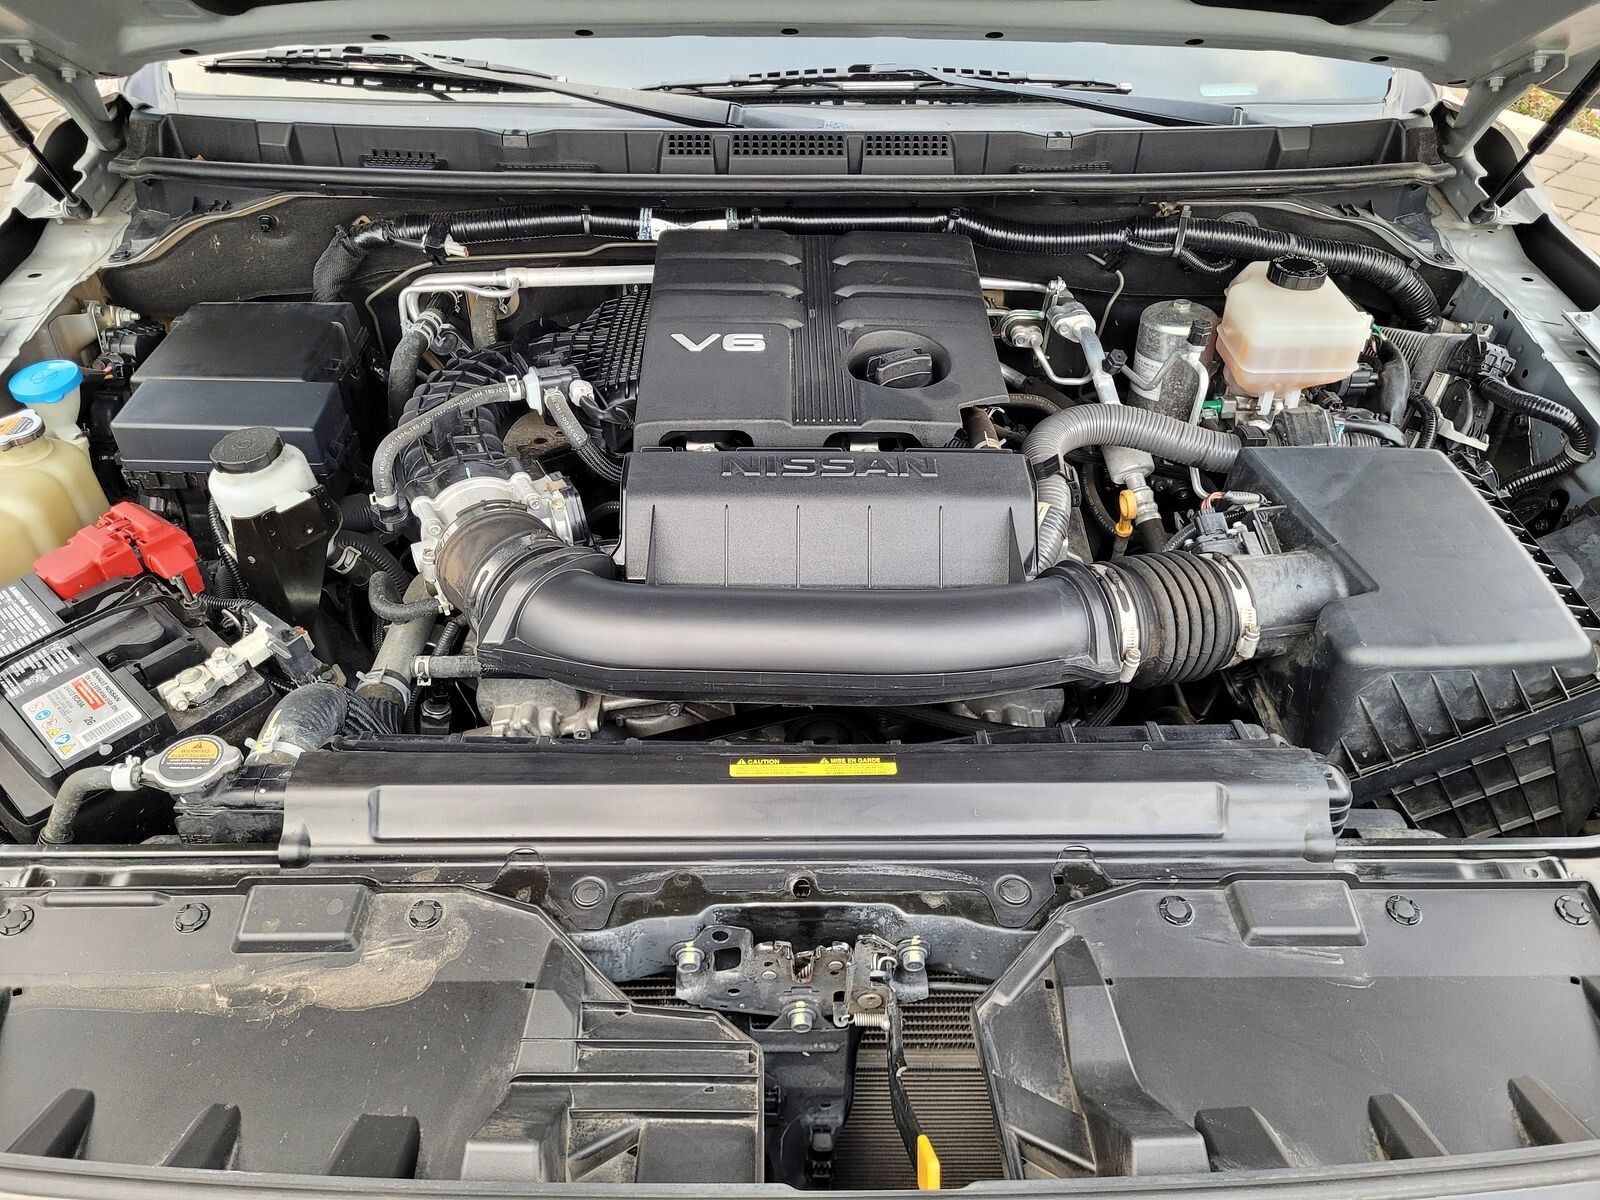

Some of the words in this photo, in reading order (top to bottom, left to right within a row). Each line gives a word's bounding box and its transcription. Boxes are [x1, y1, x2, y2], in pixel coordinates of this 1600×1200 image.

[670, 333, 766, 351] V6
[721, 455, 939, 477] NISSAN
[92, 671, 107, 686] RENAULT
[105, 684, 121, 702] NISSAN
[84, 716, 96, 726] 26
